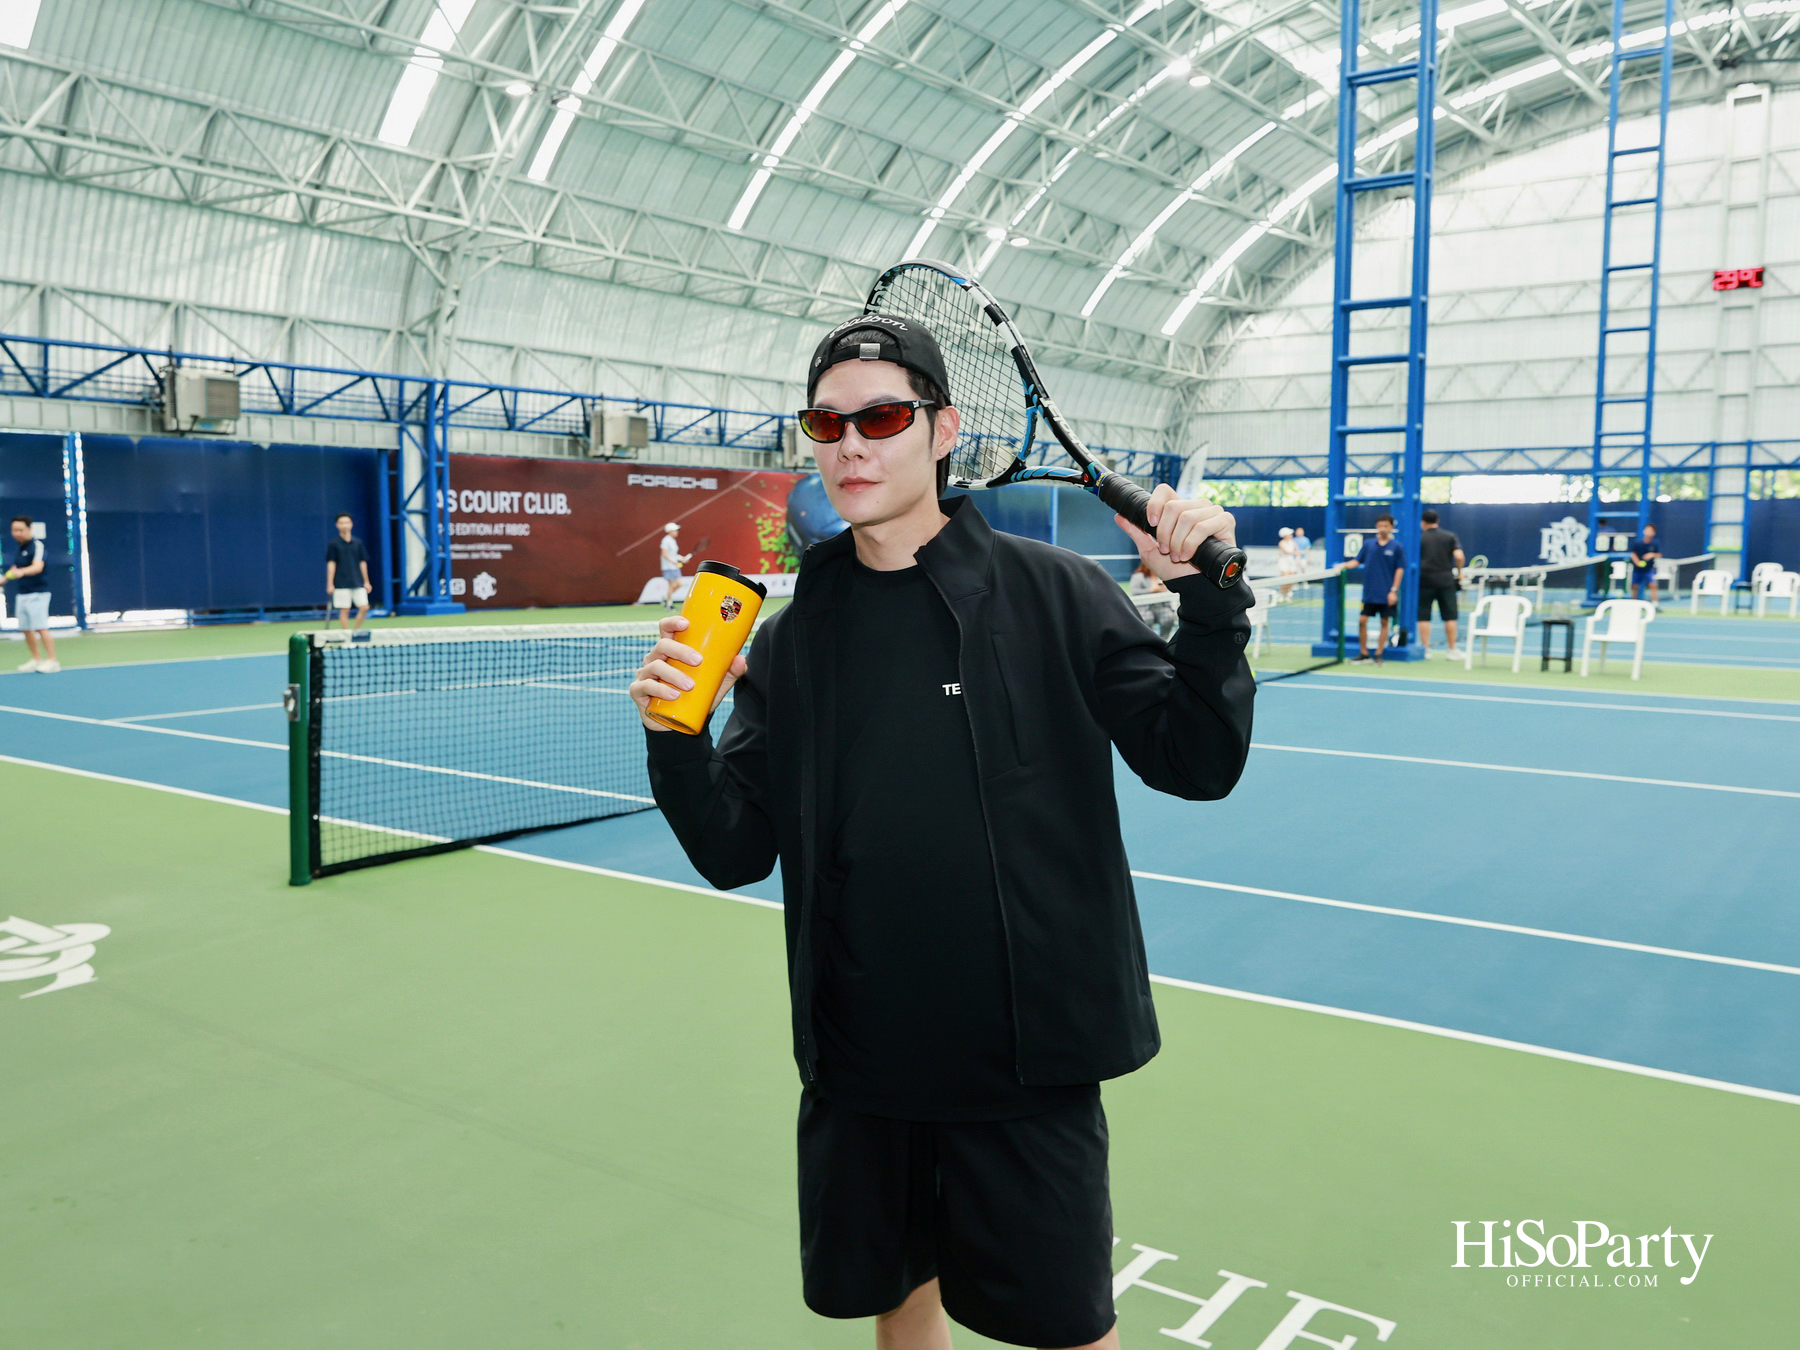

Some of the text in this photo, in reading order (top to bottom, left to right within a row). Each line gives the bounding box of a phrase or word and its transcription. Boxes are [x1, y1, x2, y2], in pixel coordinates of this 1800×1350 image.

[627, 473, 718, 490] PORSCHE
[460, 490, 522, 514] COURT
[523, 491, 572, 515] CLUB.
[942, 683, 962, 696] TE
